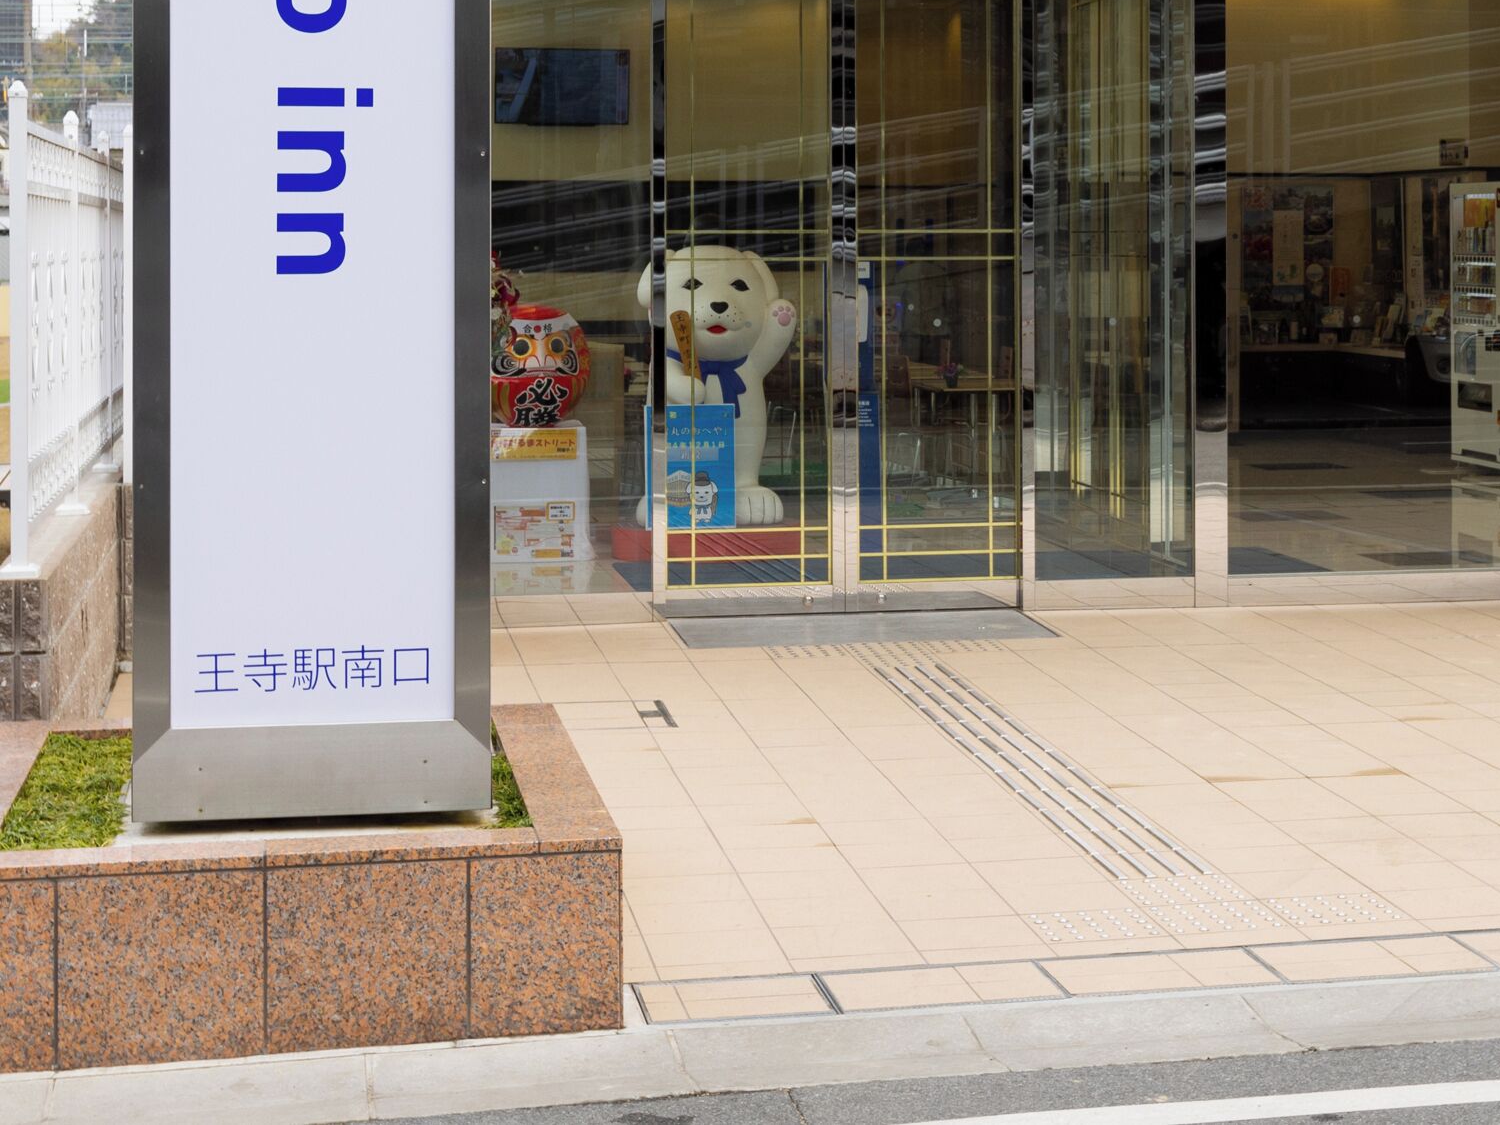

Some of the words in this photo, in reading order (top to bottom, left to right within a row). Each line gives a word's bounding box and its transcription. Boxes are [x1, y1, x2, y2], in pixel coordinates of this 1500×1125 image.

[275, 87, 374, 275] inn
[513, 376, 569, 426] 必勝
[194, 644, 430, 693] 王寺駅南口
